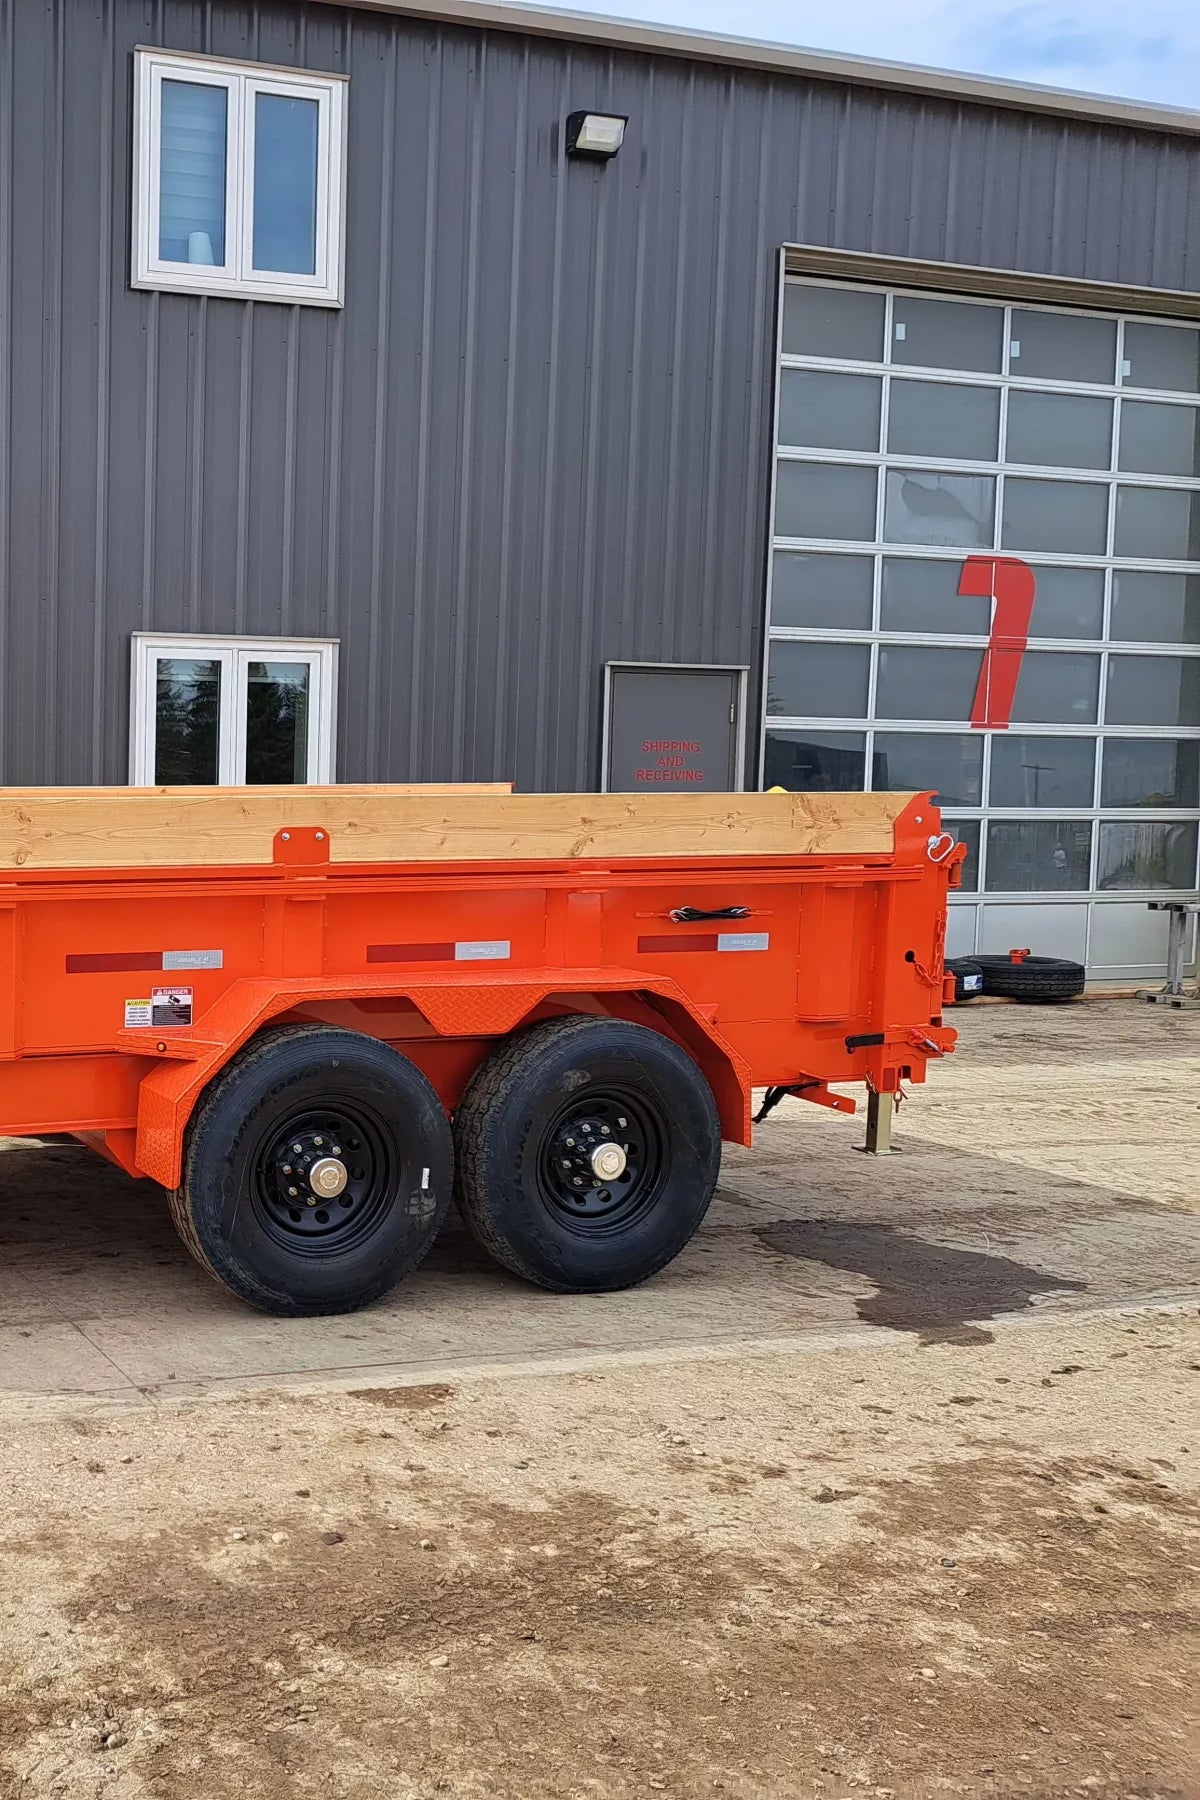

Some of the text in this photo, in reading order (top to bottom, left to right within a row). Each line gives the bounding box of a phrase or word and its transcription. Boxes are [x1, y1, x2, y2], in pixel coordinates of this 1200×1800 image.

[957, 555, 1036, 729] 7
[641, 741, 701, 753] SHIPPING
[657, 755, 684, 767] AND
[636, 769, 703, 781] RECEIVING
